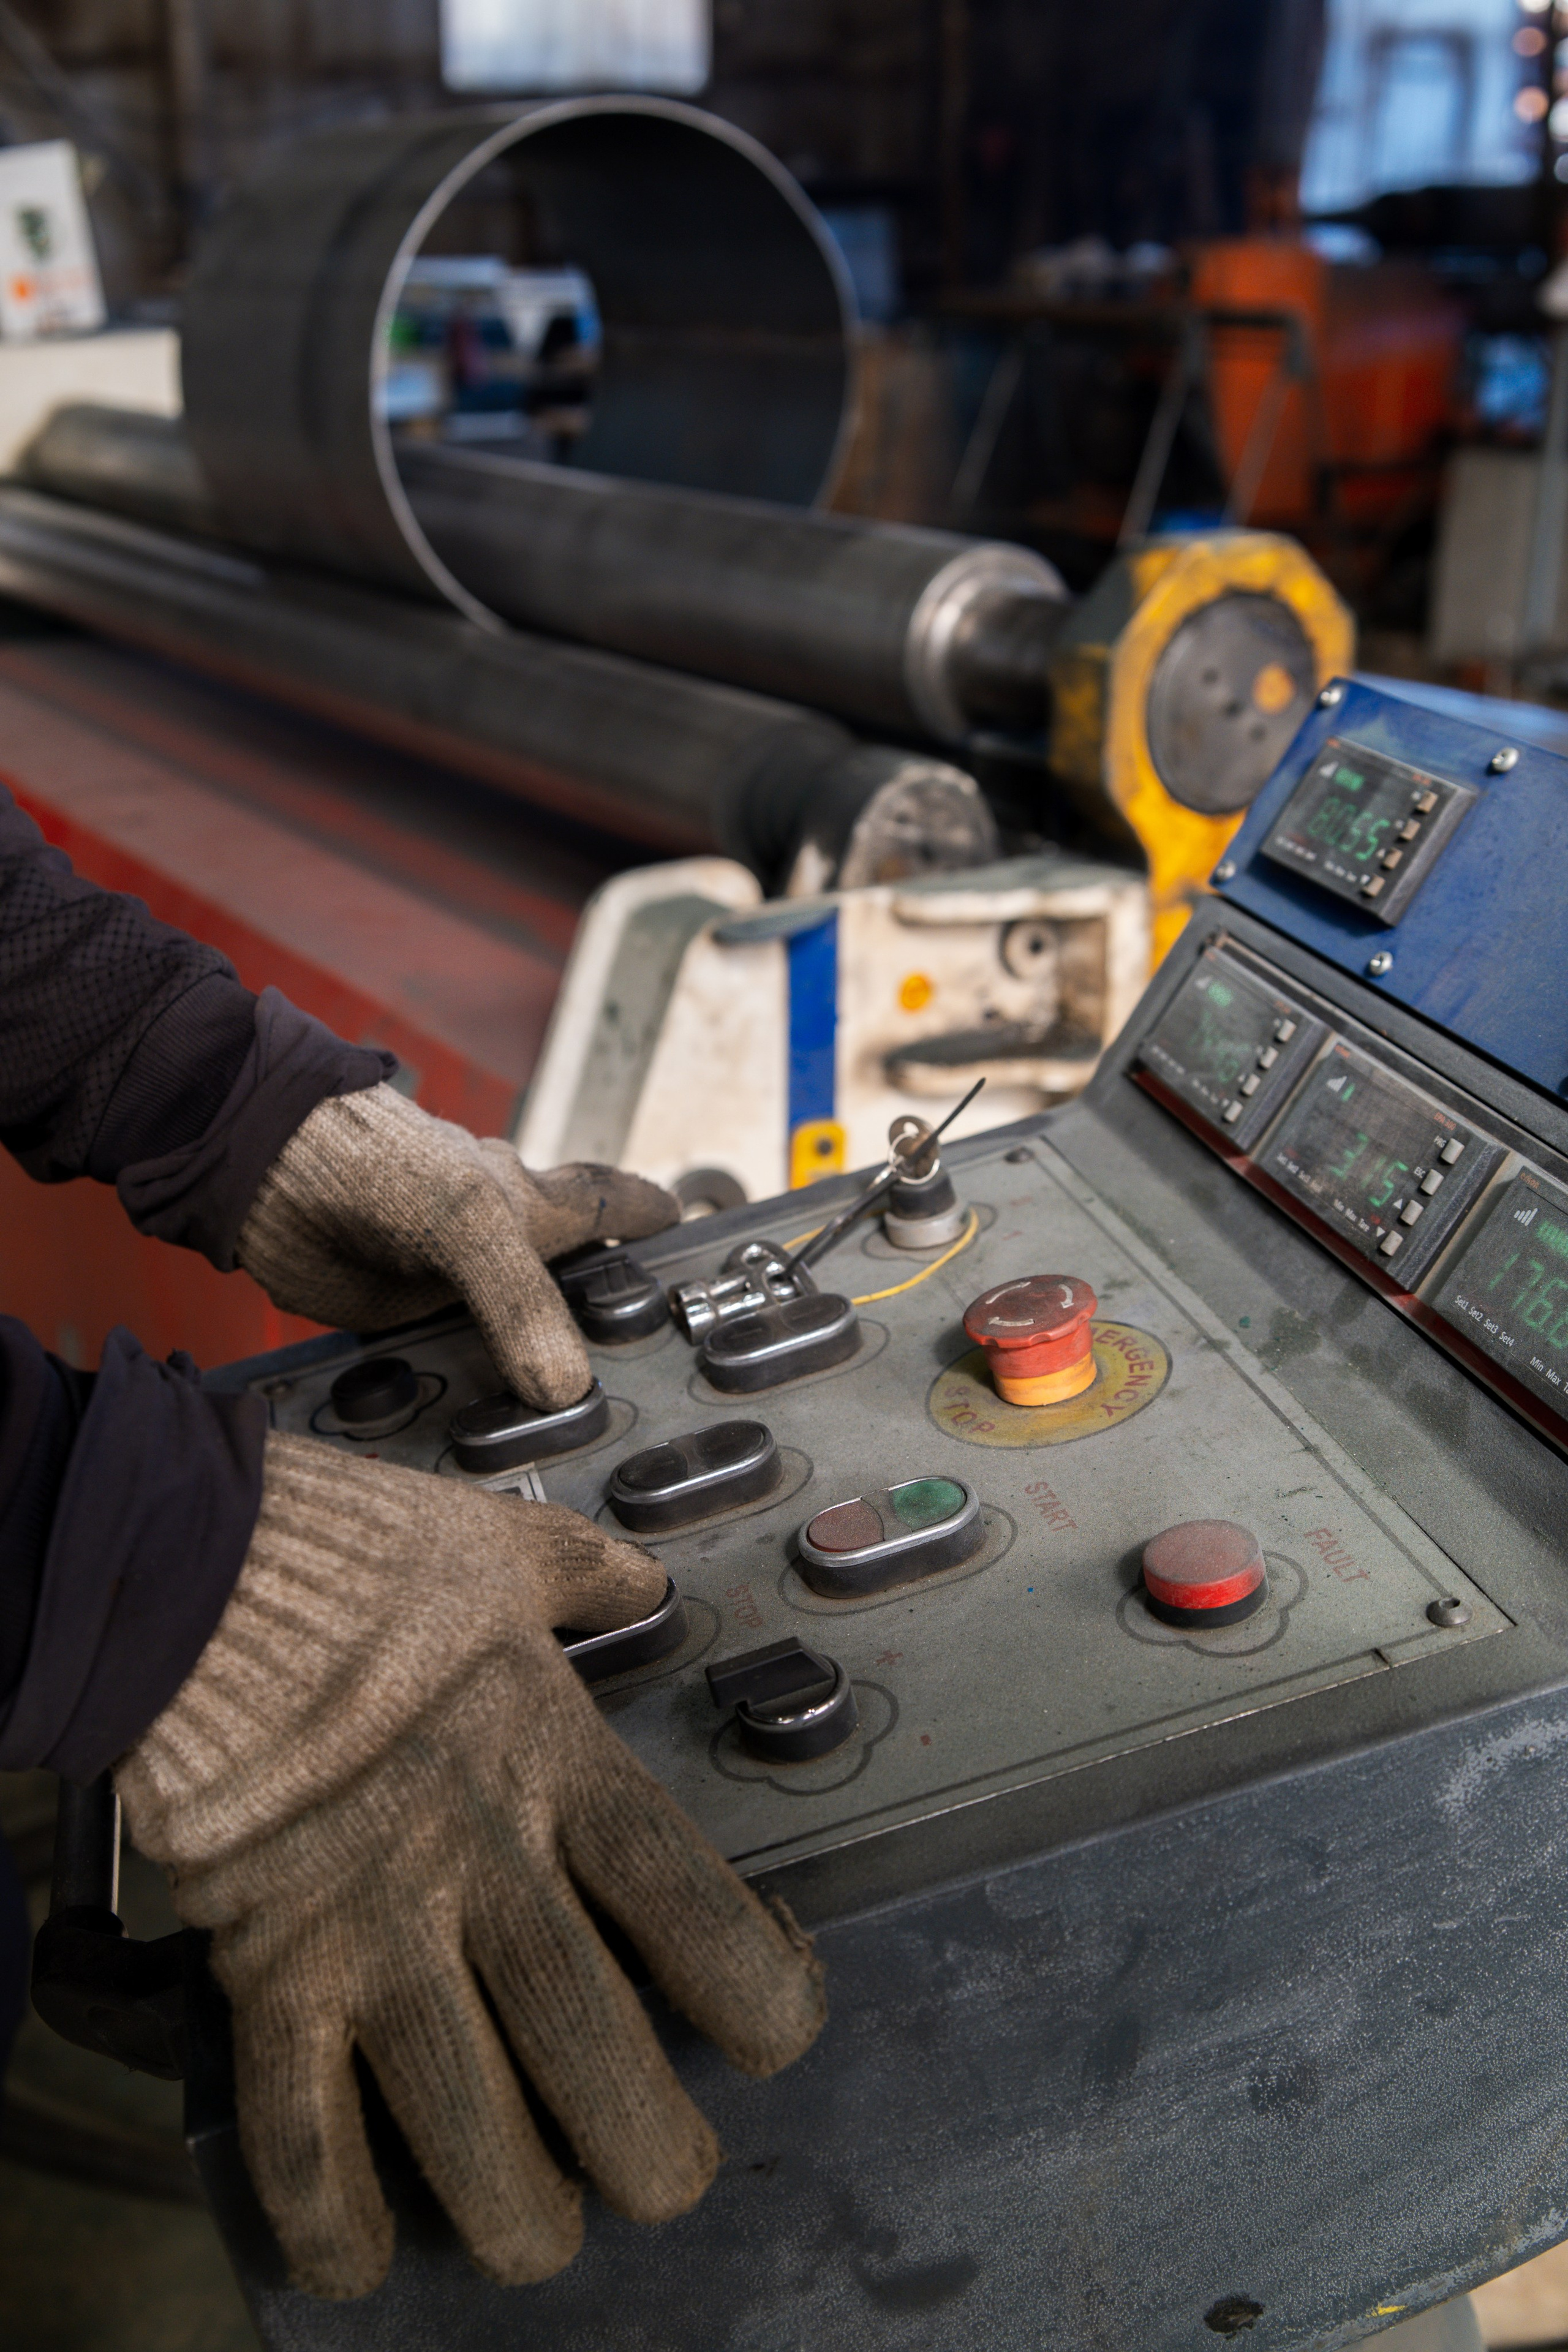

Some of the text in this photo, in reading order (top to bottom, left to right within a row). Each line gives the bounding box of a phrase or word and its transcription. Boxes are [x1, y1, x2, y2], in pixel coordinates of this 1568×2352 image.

[1414, 1167, 1426, 1178] ESC
[1455, 1295, 1515, 1347] Set1 Set2 Set3 Set4
[1091, 1327, 1155, 1418] ERGENCY
[1529, 1356, 1544, 1372] Min
[1545, 1369, 1561, 1386] Max
[943, 1385, 995, 1434] STOP
[1024, 1481, 1078, 1532] START
[1304, 1528, 1370, 1583] FAULT
[722, 1585, 763, 1628] STOP
